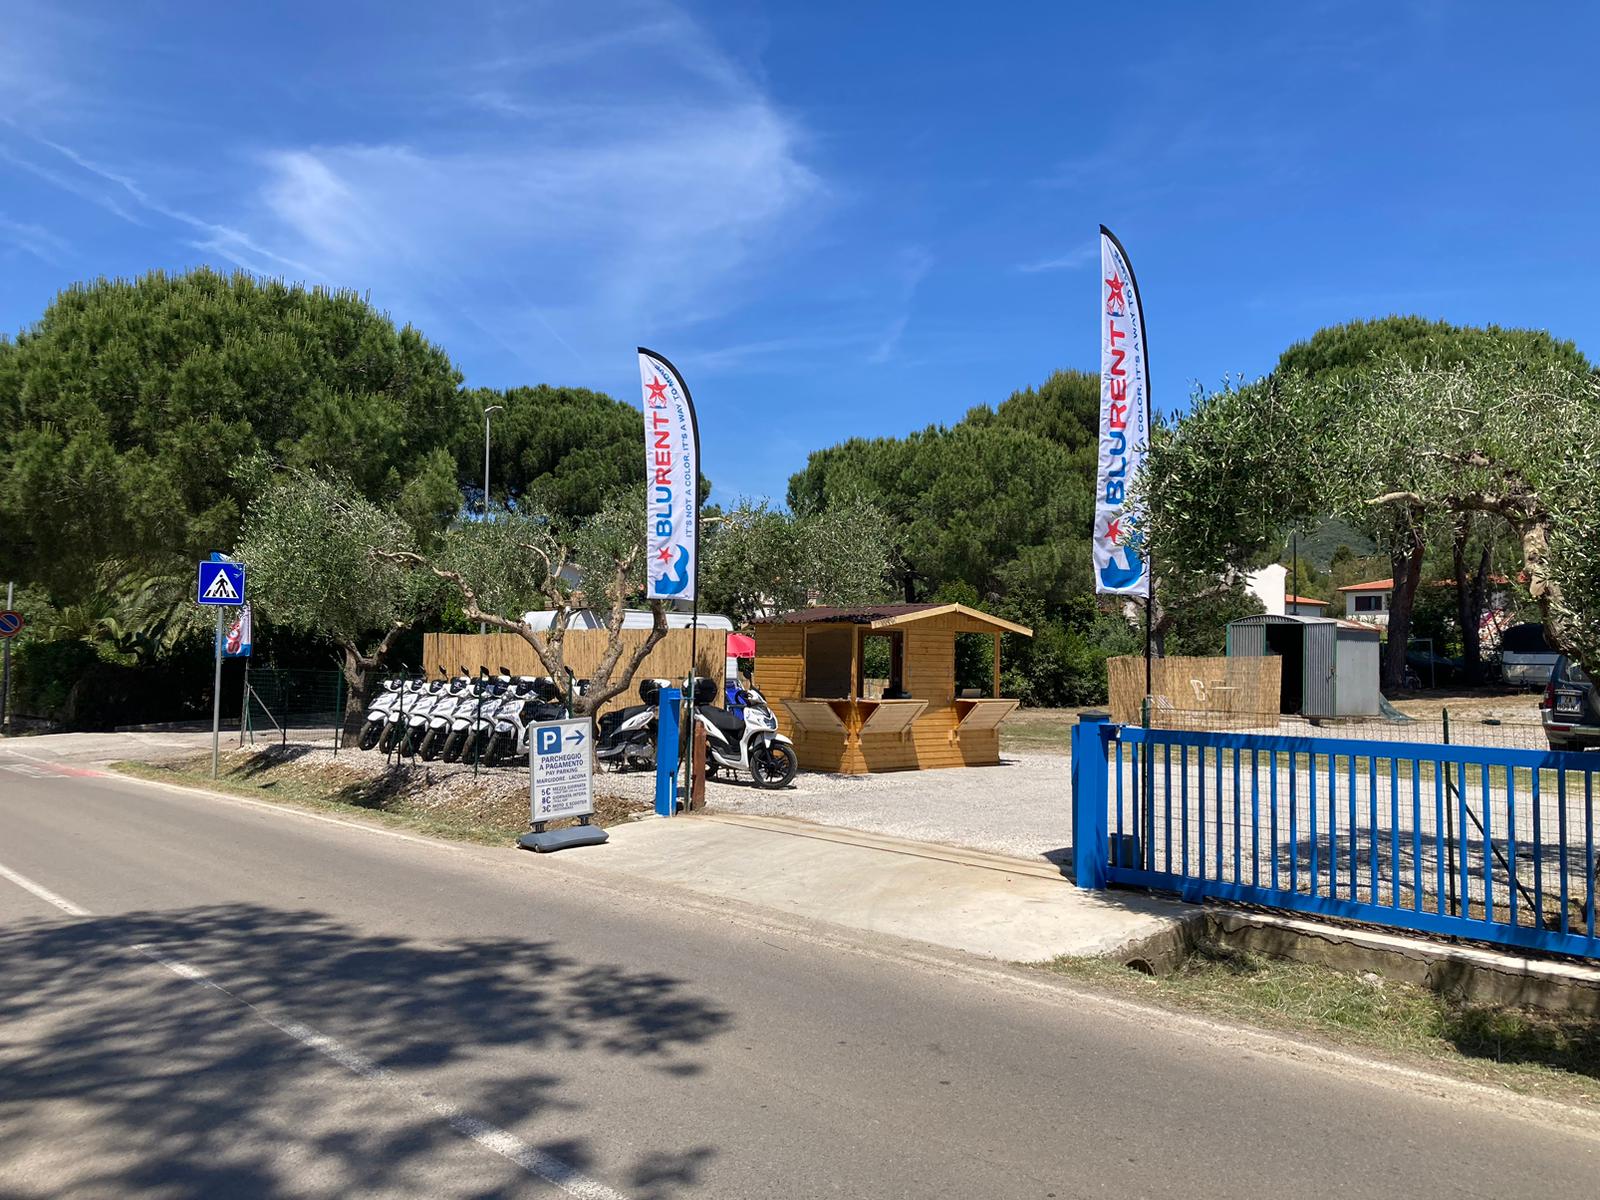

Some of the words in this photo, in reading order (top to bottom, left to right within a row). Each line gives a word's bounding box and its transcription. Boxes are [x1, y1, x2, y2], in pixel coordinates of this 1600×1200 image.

[1126, 289, 1133, 308] TO
[1129, 312, 1138, 338] WAY
[1134, 343, 1140, 351] A
[671, 388, 679, 401] TO
[675, 403, 685, 422] WAY
[1105, 320, 1127, 504] BLURENT
[653, 411, 672, 537] BLURENT
[543, 731, 557, 750] P
[541, 753, 582, 763] PARCHEGGIO
[545, 759, 583, 769] PAGAMENTO
